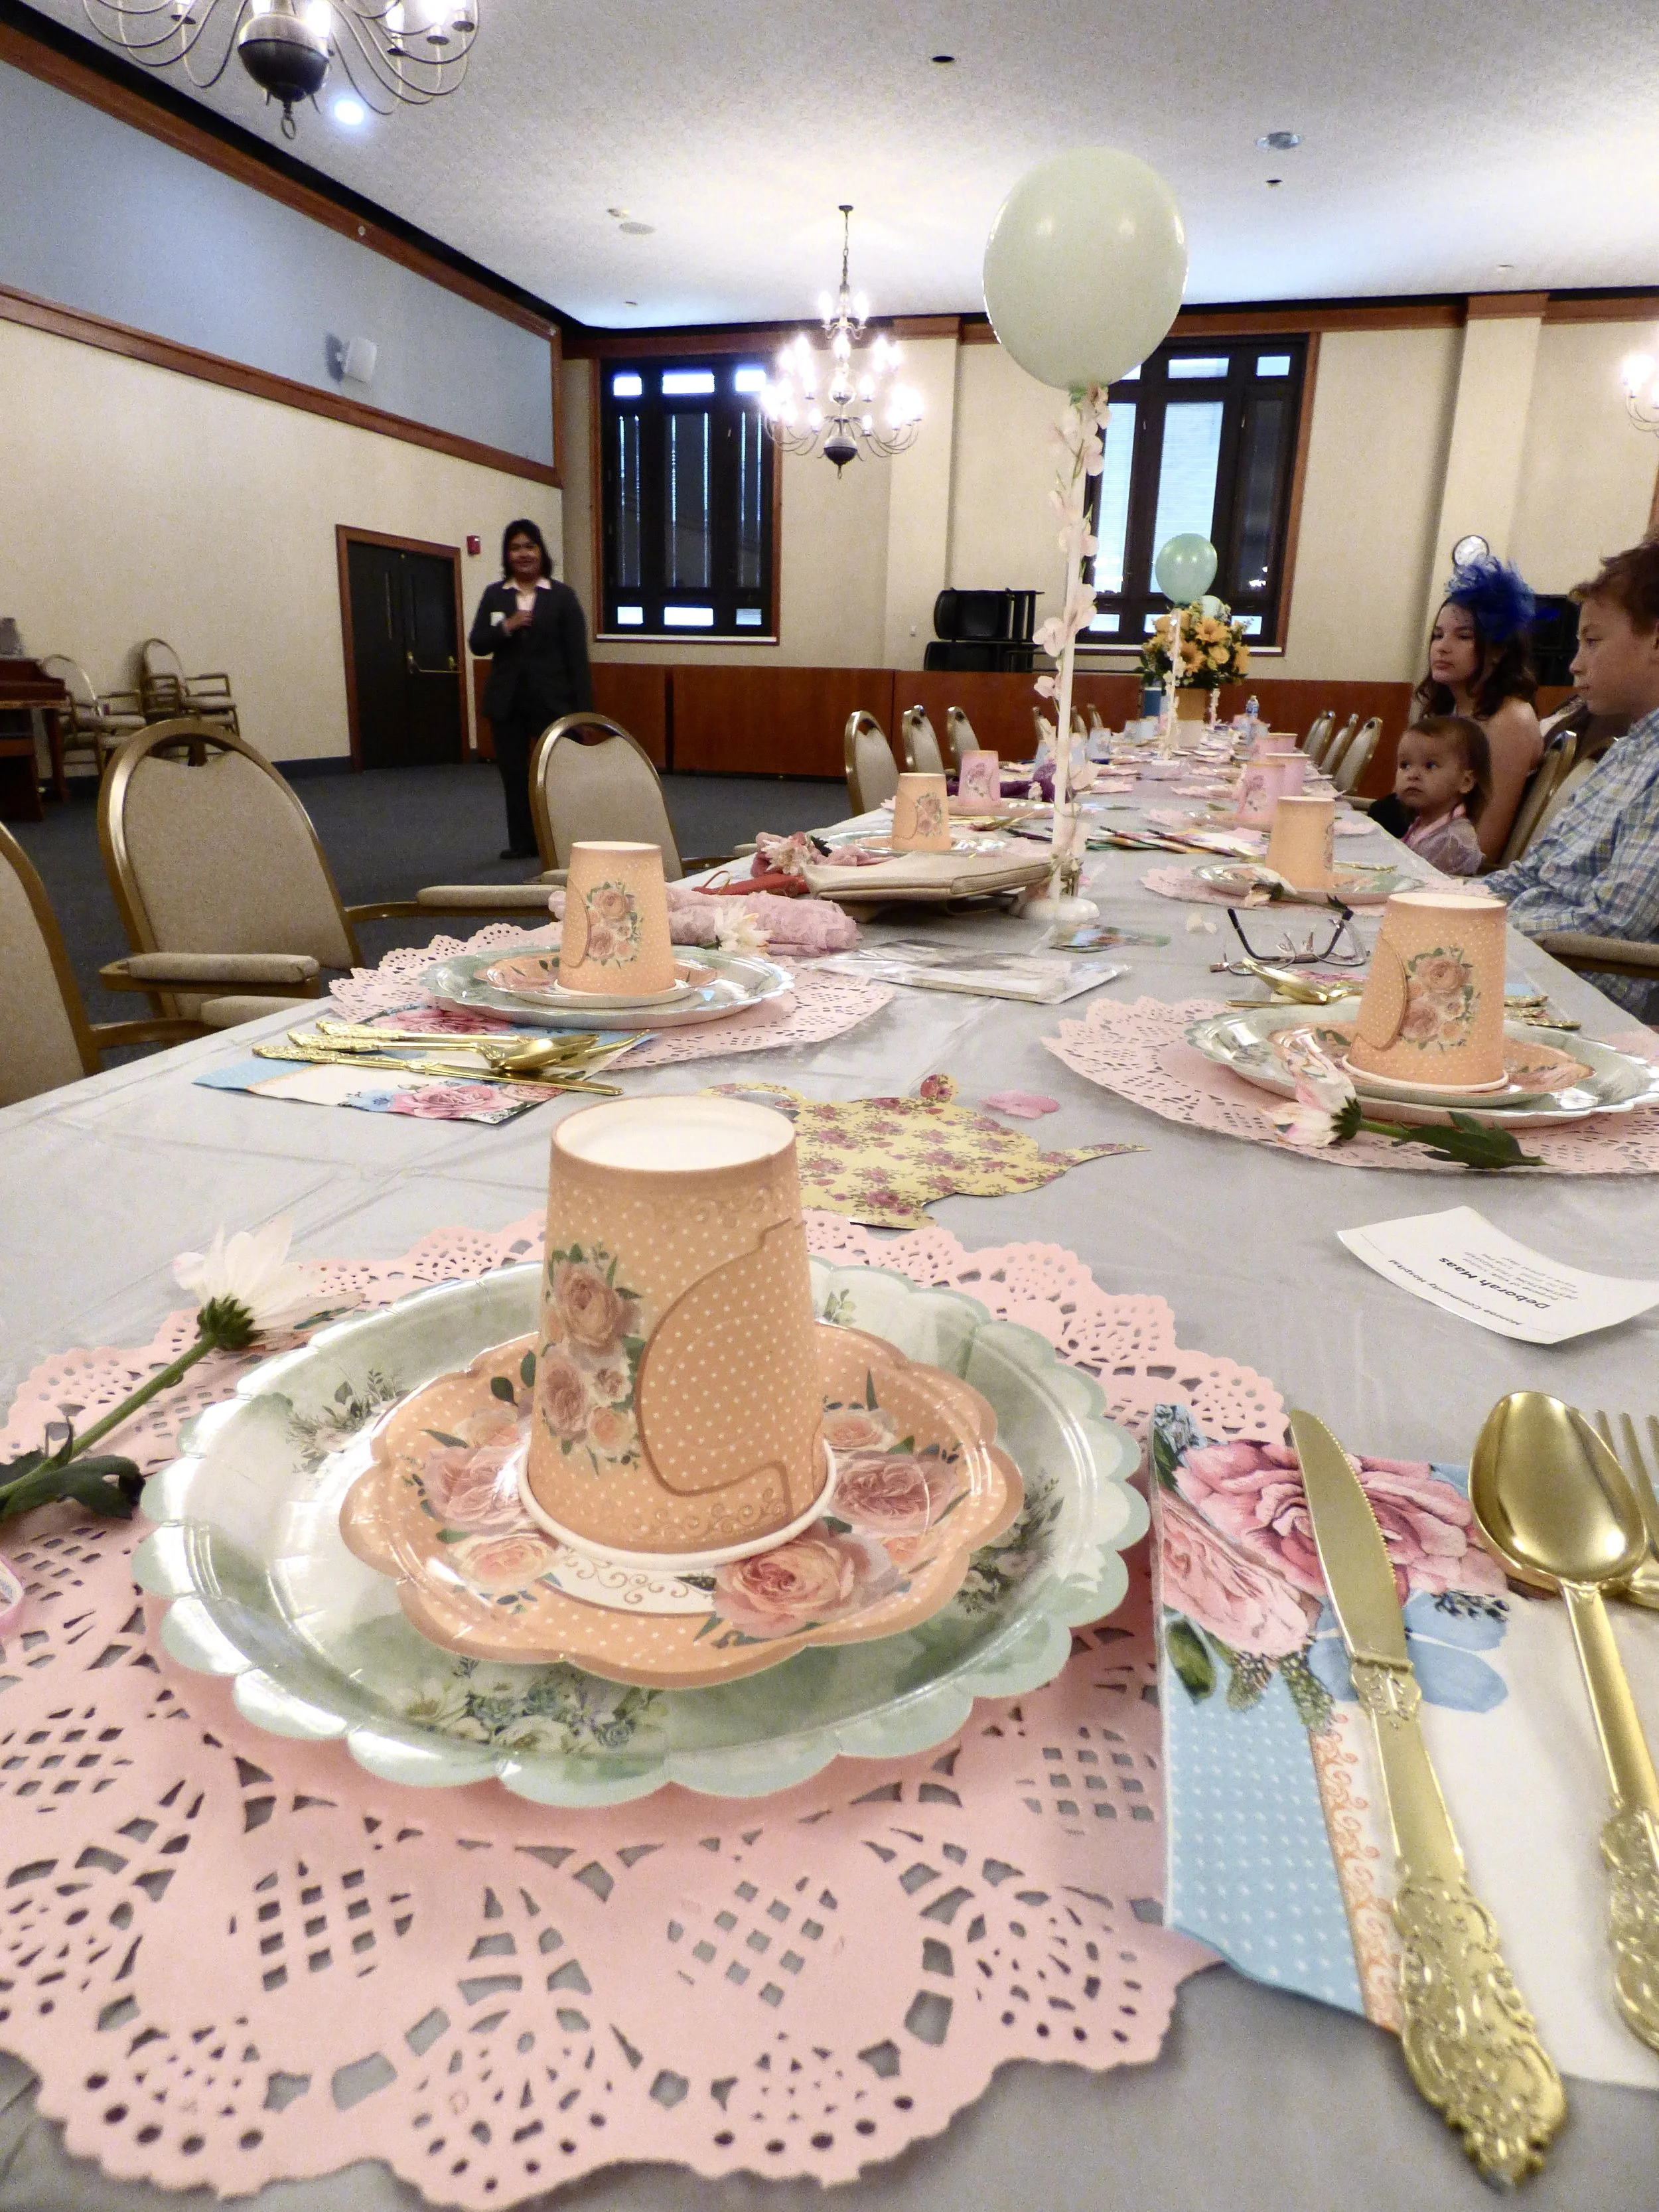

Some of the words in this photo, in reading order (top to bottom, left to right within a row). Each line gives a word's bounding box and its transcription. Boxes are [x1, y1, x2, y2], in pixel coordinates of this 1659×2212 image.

[1388, 1259, 1427, 1283] Hospital
[1438, 1257, 1478, 1280] Maas
[1427, 1282, 1482, 1310] Community
[1479, 1279, 1551, 1309] Deborah
[1483, 1309, 1523, 1325] Monroe
